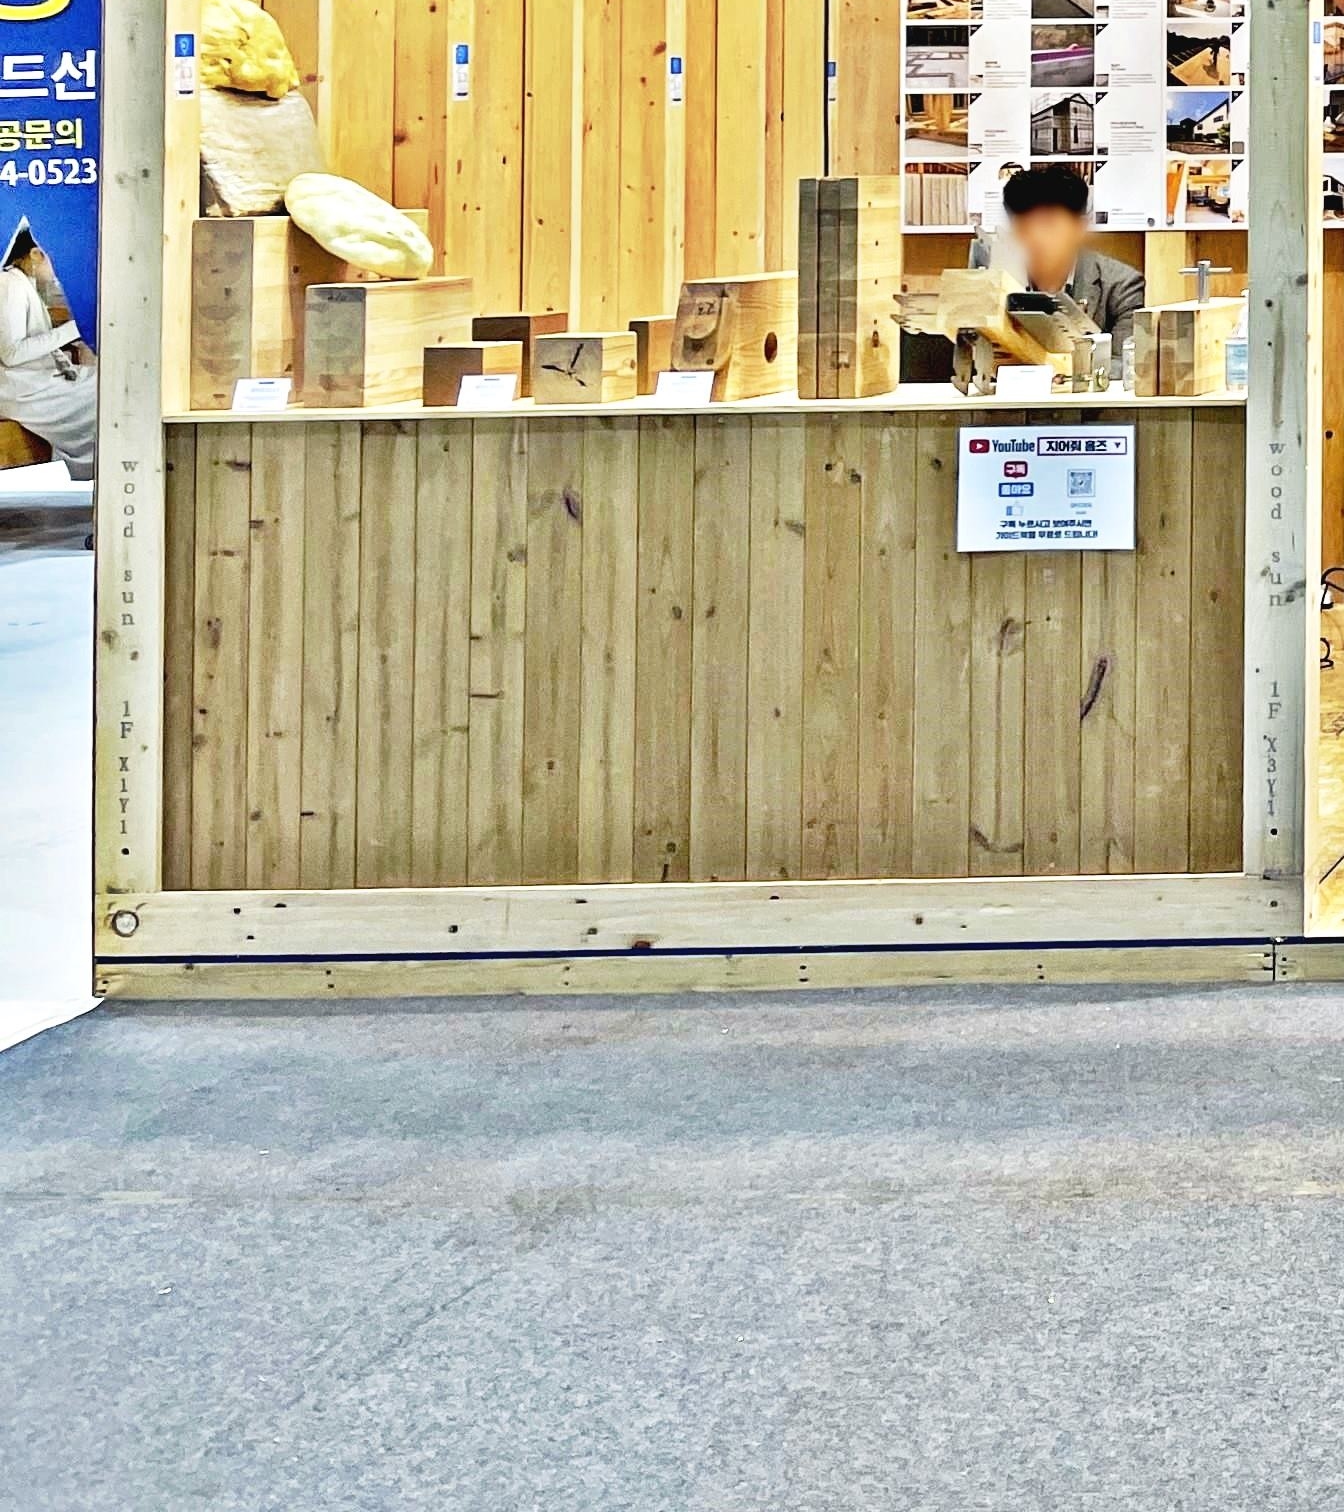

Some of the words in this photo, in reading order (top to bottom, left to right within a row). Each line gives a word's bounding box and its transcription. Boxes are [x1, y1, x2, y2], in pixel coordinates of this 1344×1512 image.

[0, 49, 96, 100] 드선
[992, 438, 1036, 453] YouTube
[120, 460, 138, 539] wood
[1269, 441, 1286, 521] wood
[120, 569, 135, 627] sun
[1269, 551, 1283, 608] sun
[119, 701, 134, 740] 1F
[1268, 681, 1283, 720] 1F
